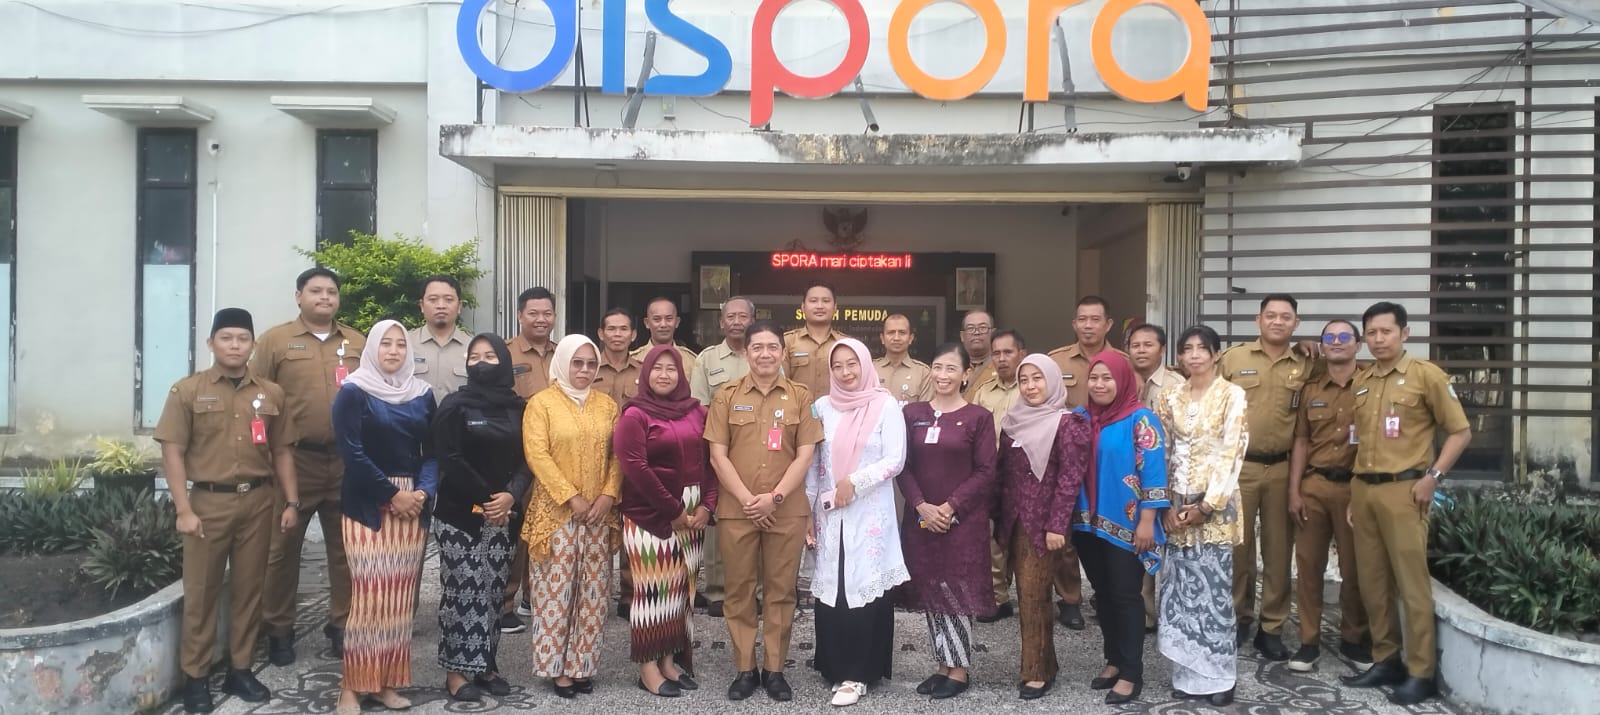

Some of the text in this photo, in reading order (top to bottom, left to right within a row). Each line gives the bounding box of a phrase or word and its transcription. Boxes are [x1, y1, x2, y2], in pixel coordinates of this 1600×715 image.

[772, 254, 817, 267] SPORA
[820, 254, 847, 267] mari
[844, 309, 888, 321] PEMUDA
